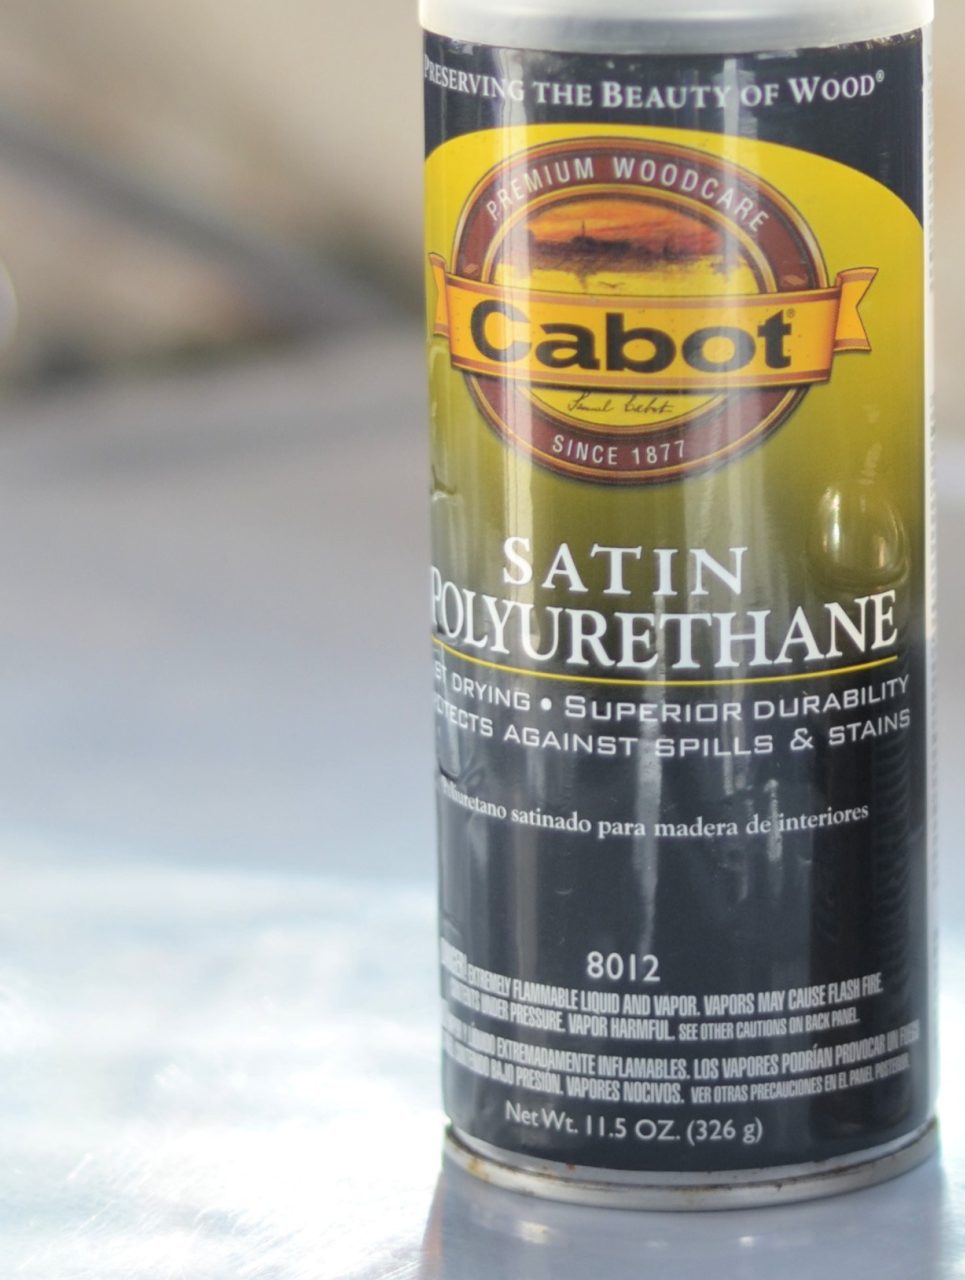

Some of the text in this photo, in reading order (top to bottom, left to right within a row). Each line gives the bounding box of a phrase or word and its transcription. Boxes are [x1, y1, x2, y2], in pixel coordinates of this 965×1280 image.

[533, 81, 593, 107] THE
[602, 81, 731, 109] BEAUTY
[740, 84, 780, 107] OF
[486, 156, 770, 234] PREMIUM WOODCARE
[552, 434, 685, 466] SINCE 1877
[503, 536, 749, 596] SATIN
[432, 565, 899, 670] POLYURETHANE
[452, 671, 531, 711] DRYING
[564, 694, 742, 723] SUPERIOR
[754, 674, 910, 720] DURABILITY
[503, 723, 638, 757] AGAINST
[655, 733, 774, 758] SPILLS
[789, 727, 815, 752] &
[828, 708, 911, 746] STAINS
[510, 807, 592, 833] satinado
[598, 820, 646, 839] para
[653, 816, 739, 837] madera
[745, 813, 772, 834] de
[778, 804, 870, 832] interiores
[587, 950, 661, 982] 8012
[513, 978, 578, 1010] FLAMMABLE
[580, 989, 620, 1014] LIQUID
[622, 993, 651, 1016] AND
[653, 995, 700, 1017] VAPOR.
[704, 992, 755, 1017] VAPORS
[757, 989, 786, 1014] MAY
[788, 984, 827, 1011] CAUSE
[828, 977, 861, 1004] FLASH
[510, 1001, 566, 1033] PRESSURE.
[568, 1012, 608, 1038] VAPOR
[610, 1016, 676, 1041] HARMFUL.
[678, 1022, 699, 1042] SEE
[701, 1021, 735, 1041] OTHER
[736, 1017, 787, 1039] CAUTIONS
[788, 1015, 804, 1035] ON
[805, 1011, 831, 1033] BACK
[496, 1036, 596, 1076] EXTREMADAMENTE
[597, 1054, 691, 1080] INFLAMABLES.
[694, 1057, 719, 1080] LOS
[722, 1053, 779, 1079] VAPORES
[781, 1042, 833, 1074] PODRÍAN
[834, 1033, 886, 1066] PROVOCAR
[566, 1075, 621, 1102] VAPORES
[623, 1080, 685, 1104] NOCIVOS.
[691, 1085, 712, 1104] VER
[713, 1084, 749, 1103] OTRAS
[750, 1075, 823, 1102] PRECAUCIONES
[824, 1072, 837, 1093] EN
[838, 1071, 848, 1091] EL
[849, 1065, 875, 1087] PANEL
[505, 1100, 764, 1146] Net Wt. 11.5 OZ. (326 g)
